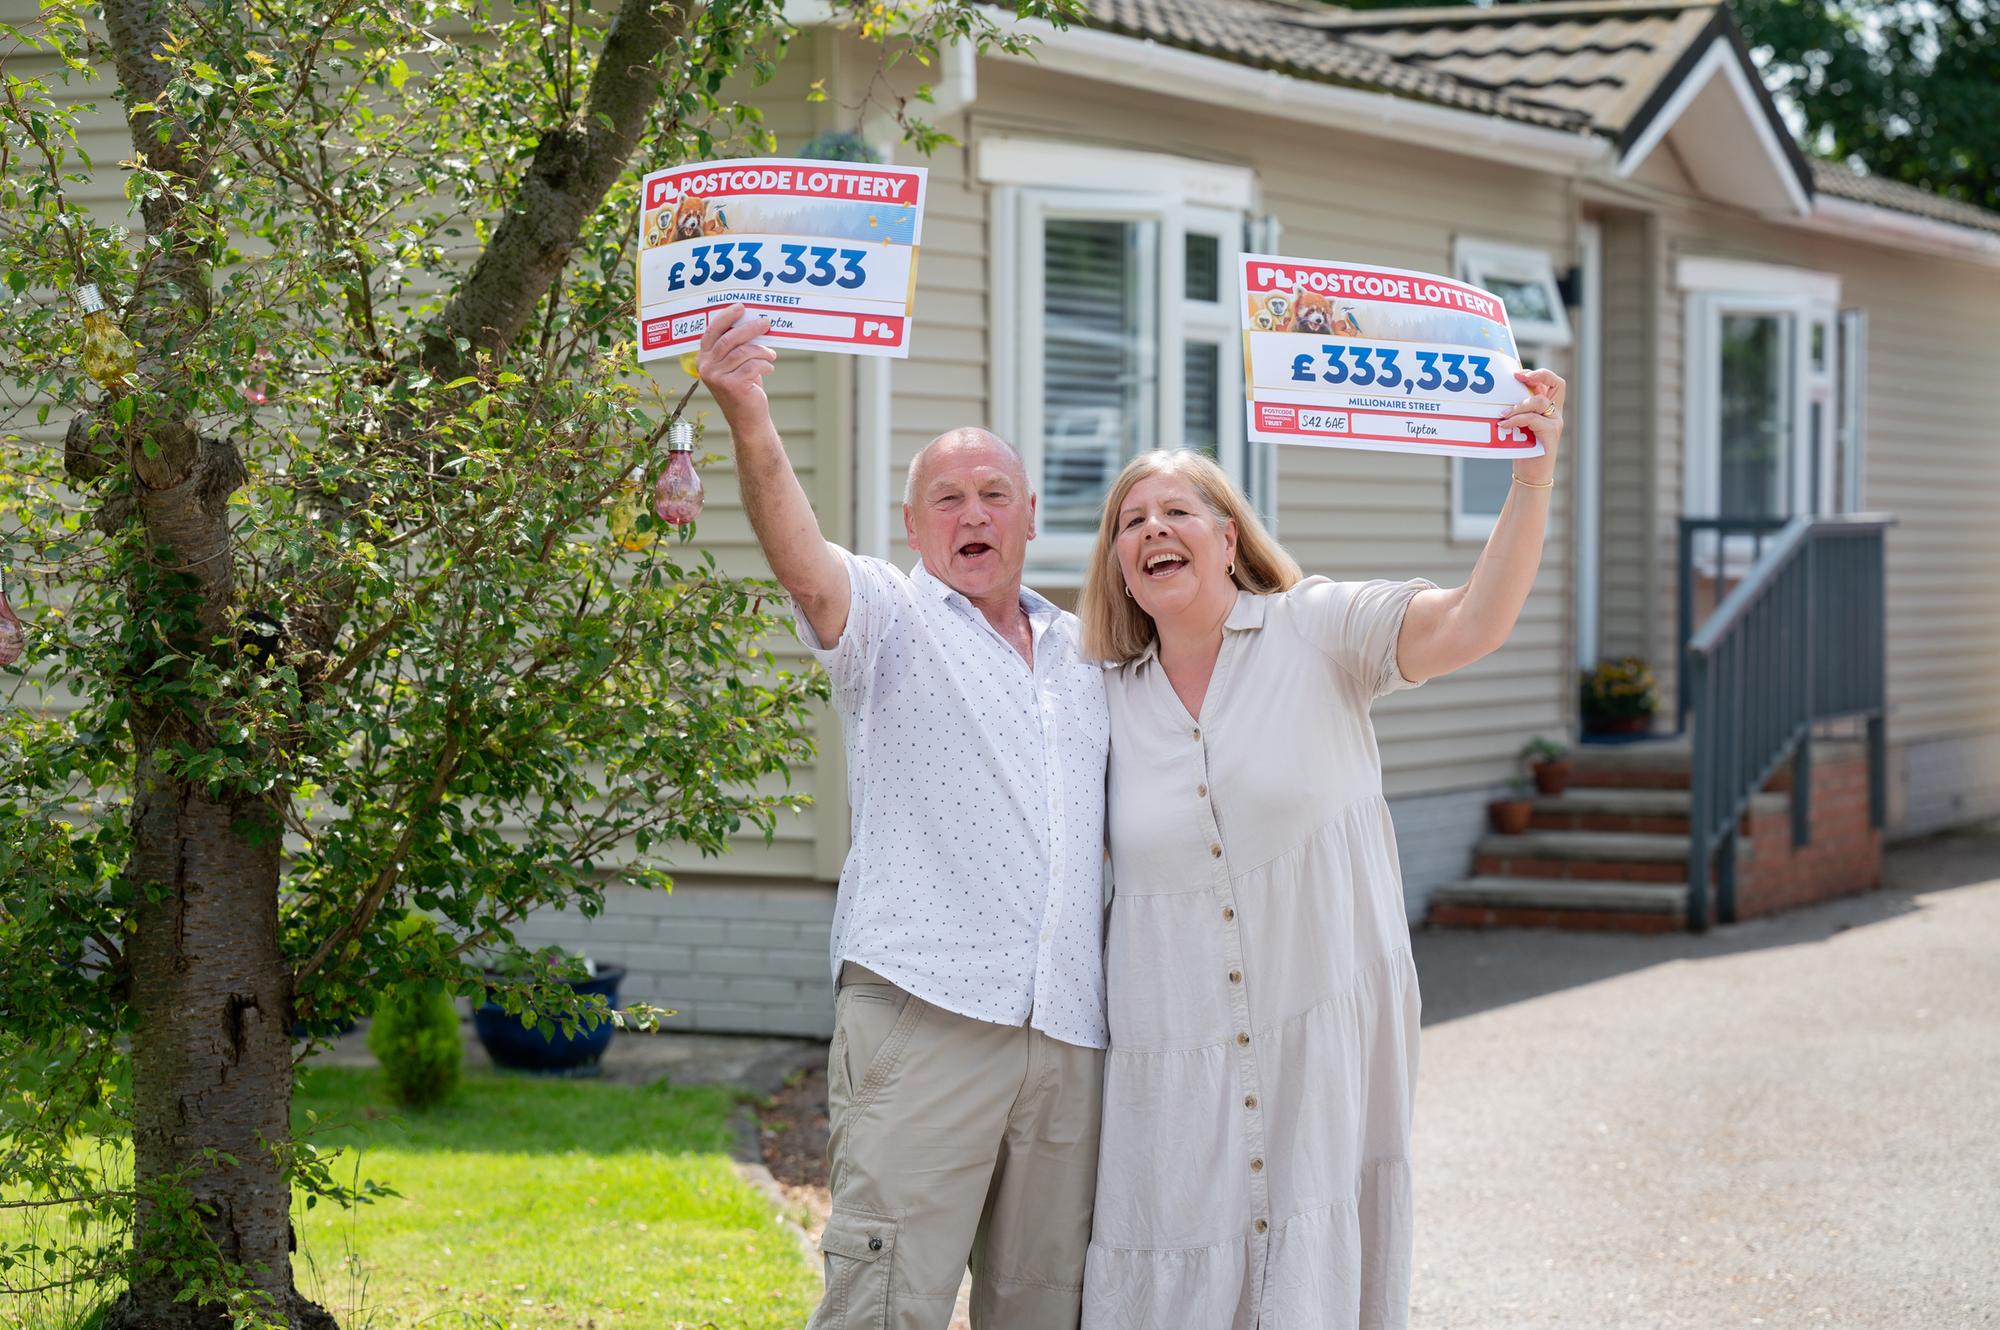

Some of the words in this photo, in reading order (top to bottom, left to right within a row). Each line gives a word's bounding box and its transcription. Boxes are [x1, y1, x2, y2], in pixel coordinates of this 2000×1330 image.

[681, 171, 792, 195] POSTCODE
[796, 172, 907, 198] LOTTERY
[667, 243, 867, 292] £333,333
[707, 292, 762, 304] MILLIONAIRE
[764, 294, 801, 305] STREET
[1295, 270, 1411, 299] POSTCODE
[1413, 282, 1495, 317] LOTTERY
[674, 322, 688, 336] S42
[758, 313, 794, 330] Tpton
[1291, 344, 1495, 394] £333,333
[1348, 397, 1406, 410] MILLIONAIRE
[1408, 402, 1440, 412] STREET
[1302, 415, 1322, 428] S42
[1325, 416, 1346, 429] 6AE
[1405, 421, 1439, 438] Tupton
